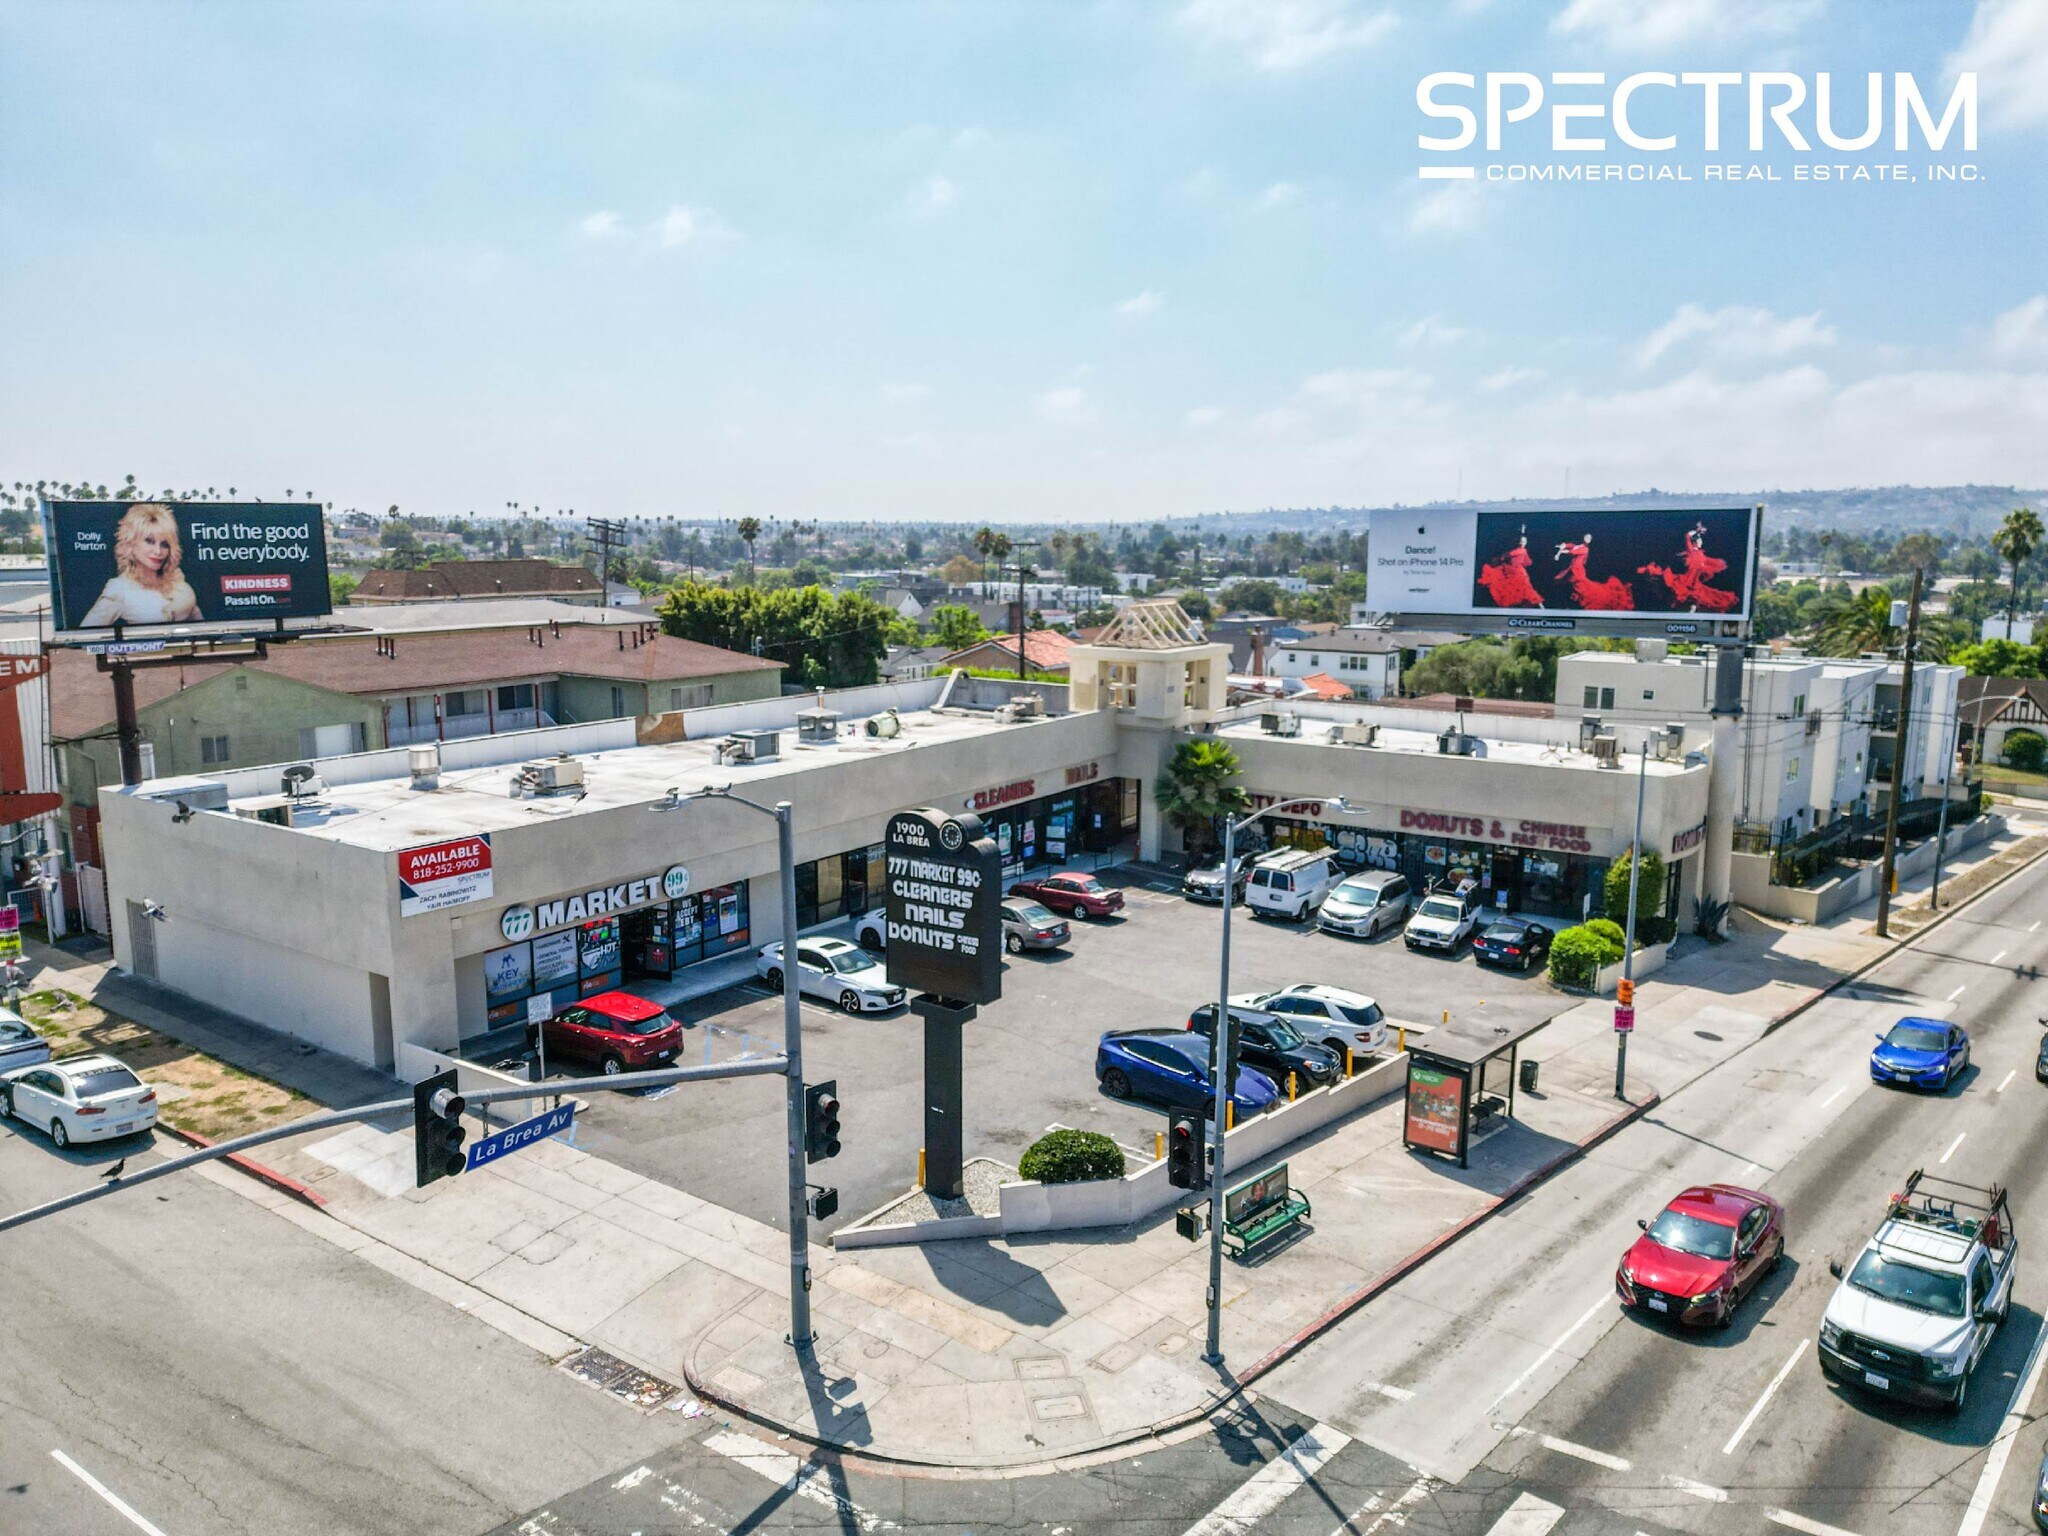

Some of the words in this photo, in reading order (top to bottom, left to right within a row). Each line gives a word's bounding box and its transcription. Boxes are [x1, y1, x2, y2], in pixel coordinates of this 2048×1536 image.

[77, 532, 101, 543] Dolly
[191, 523, 229, 540] Find
[232, 523, 262, 540] the
[265, 523, 309, 543] good
[74, 541, 107, 551] Parton
[198, 543, 215, 560] in
[217, 543, 310, 563] everybody.
[1405, 545, 1436, 555] Dance!
[1377, 557, 1396, 567] Shot
[1397, 559, 1408, 567] on
[1409, 557, 1438, 567] iPhone
[1439, 558, 1449, 566] 14
[1450, 558, 1465, 567] Pro
[225, 578, 289, 590] KINDNESS
[108, 642, 165, 653] OUTFRONT
[1065, 762, 1099, 786] NAILS
[895, 821, 926, 837] 1900
[1400, 810, 1484, 837] DONUTS
[1489, 819, 1505, 839] &
[1519, 820, 1586, 839] CHINESE
[893, 832, 906, 844] LA
[906, 835, 931, 848] BREA
[1511, 832, 1548, 847] FAST
[1548, 836, 1592, 853] FOOD
[410, 844, 480, 869] AVAILABLE
[413, 857, 480, 880] 818-252-9900
[888, 856, 909, 877] 777
[910, 860, 956, 884] MARKET
[457, 871, 490, 886] SPECTRUM
[892, 879, 974, 910] CLEANERS
[504, 913, 531, 936] 777
[537, 876, 661, 930] MARKET
[676, 905, 698, 921] ACCEPT
[680, 915, 694, 926] EBT
[904, 902, 966, 930] NAILS
[887, 920, 956, 951] DONUTS
[600, 941, 618, 956] HOT
[960, 944, 978, 956] FOOD
[497, 967, 520, 982] KEY
[475, 1144, 497, 1162] La
[503, 1123, 542, 1150] Brea
[547, 1112, 568, 1130] Av
